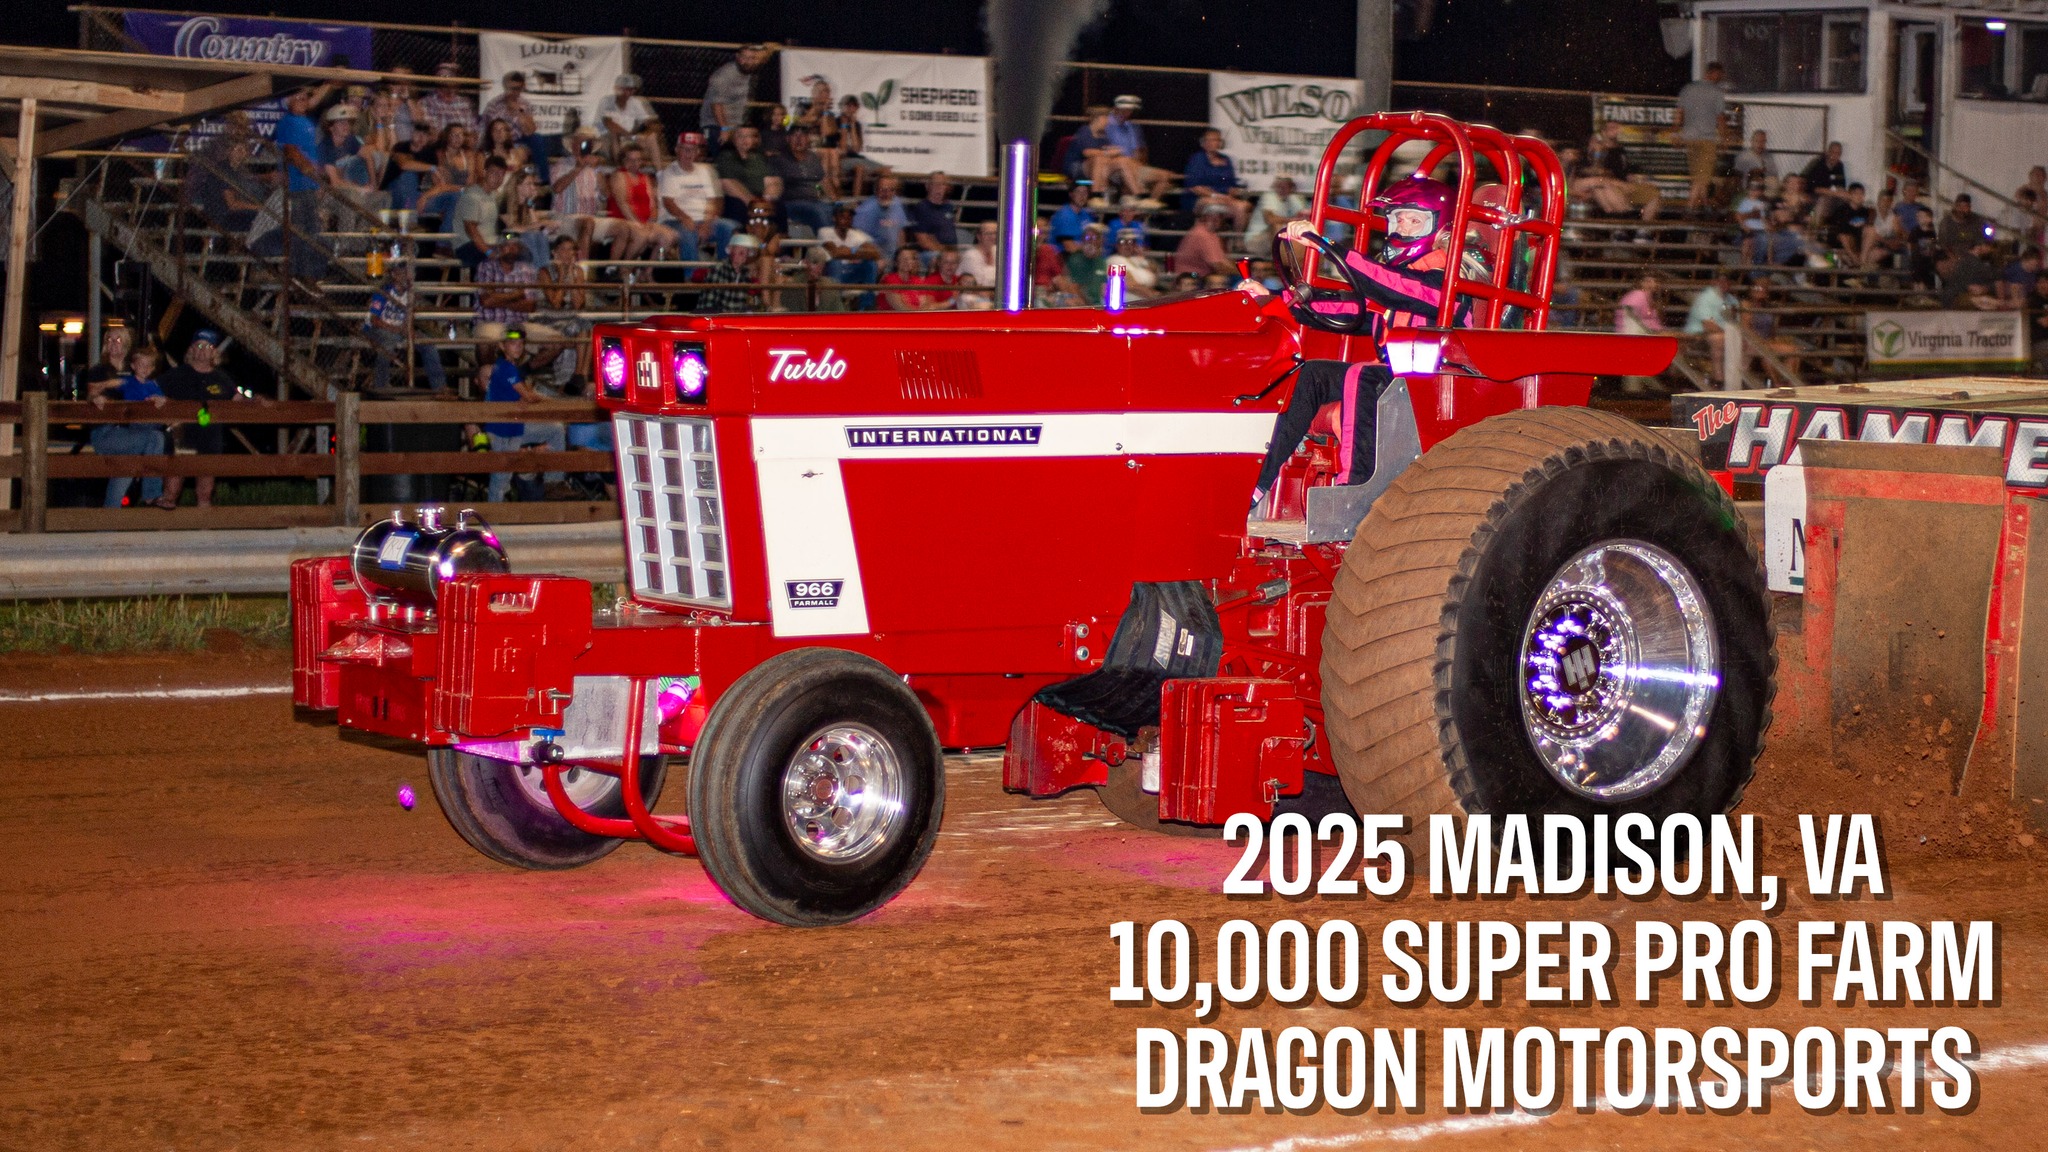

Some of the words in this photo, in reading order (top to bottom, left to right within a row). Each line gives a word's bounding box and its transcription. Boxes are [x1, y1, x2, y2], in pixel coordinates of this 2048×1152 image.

[174, 16, 324, 67] Country
[901, 87, 977, 106] SHEPHERD
[910, 110, 932, 121] SONS
[936, 111, 959, 122] SEED
[962, 112, 978, 123] LLC
[1908, 331, 1962, 350] Virginia
[1967, 331, 2015, 347] Tractor
[769, 349, 846, 381] Turbo
[1692, 401, 1738, 441] The
[853, 428, 1036, 444] INTERNATIONAL
[795, 582, 834, 597] 966
